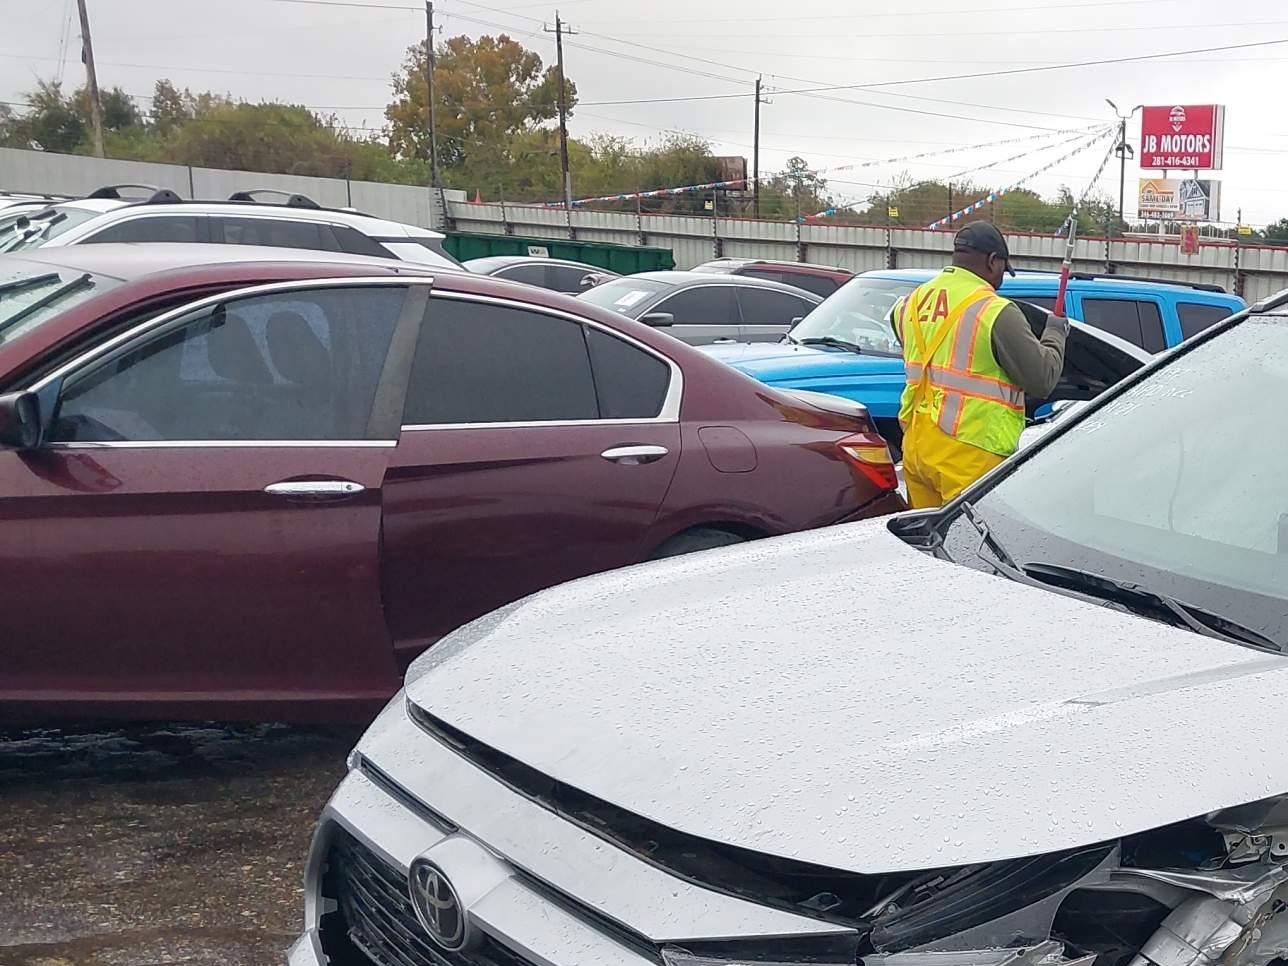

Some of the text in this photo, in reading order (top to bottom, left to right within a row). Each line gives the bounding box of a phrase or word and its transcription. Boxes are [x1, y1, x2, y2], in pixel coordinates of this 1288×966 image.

[1143, 134, 1210, 153] JB MOTORS
[1151, 156, 1199, 166] 281-416-4341
